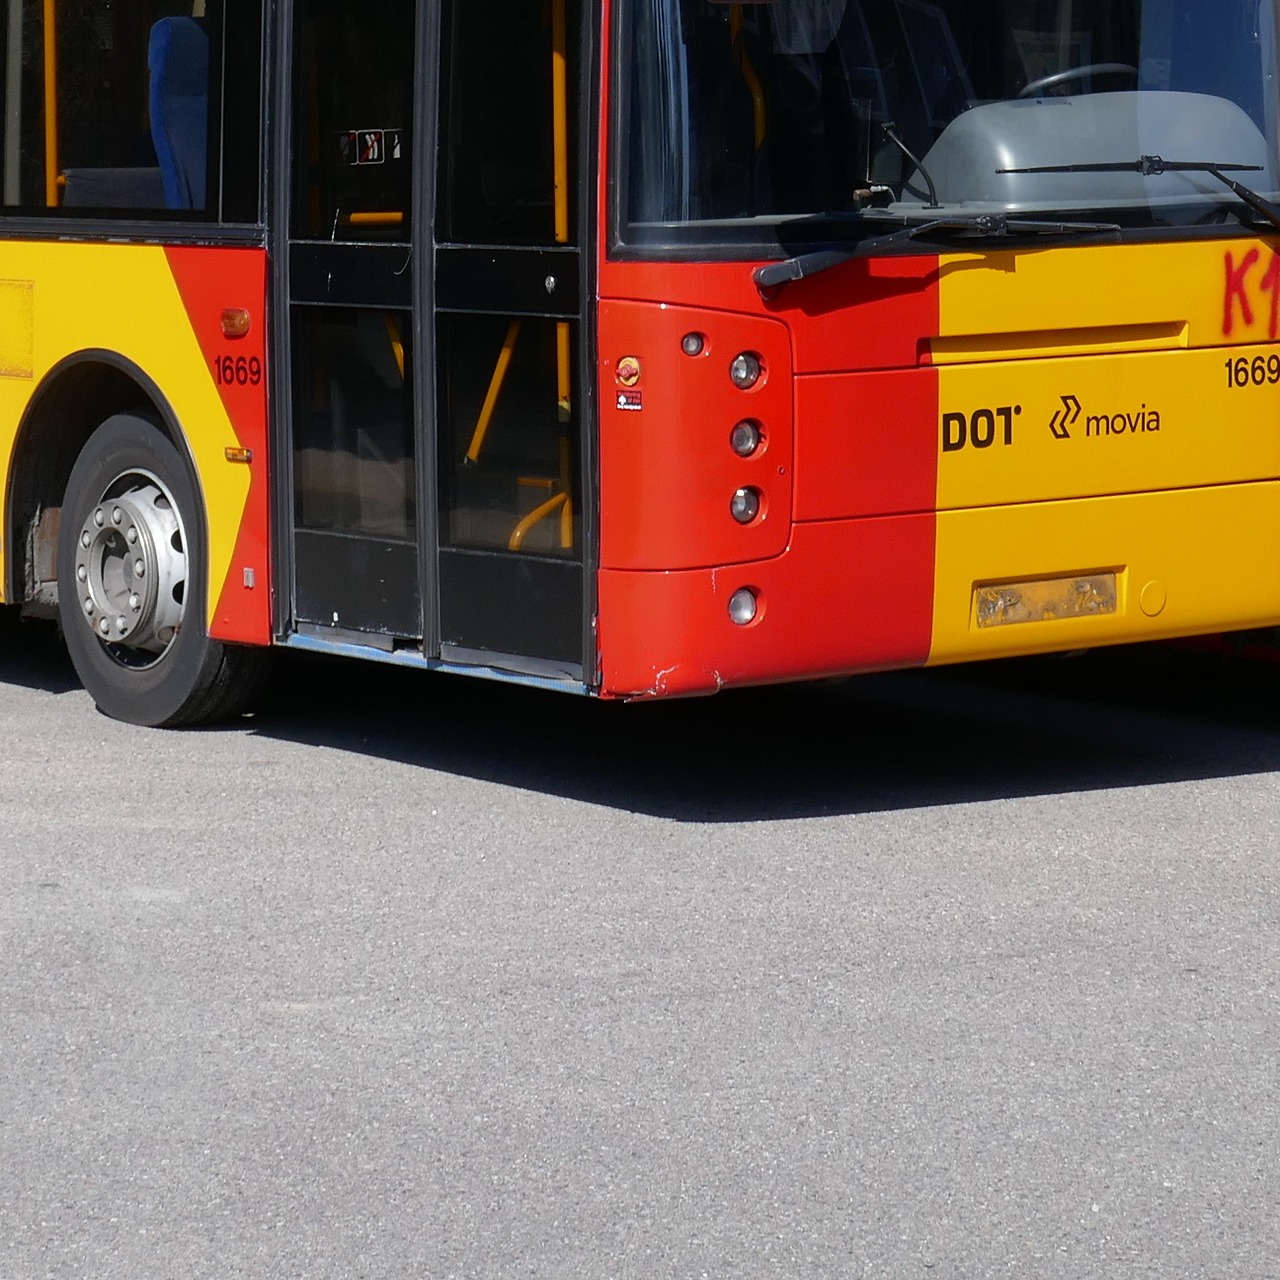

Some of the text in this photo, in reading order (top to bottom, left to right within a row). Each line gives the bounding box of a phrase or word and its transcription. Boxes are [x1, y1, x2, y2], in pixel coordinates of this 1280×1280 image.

[214, 355, 261, 386] 1669
[1225, 354, 1280, 388] 1669
[1086, 403, 1161, 437] movia
